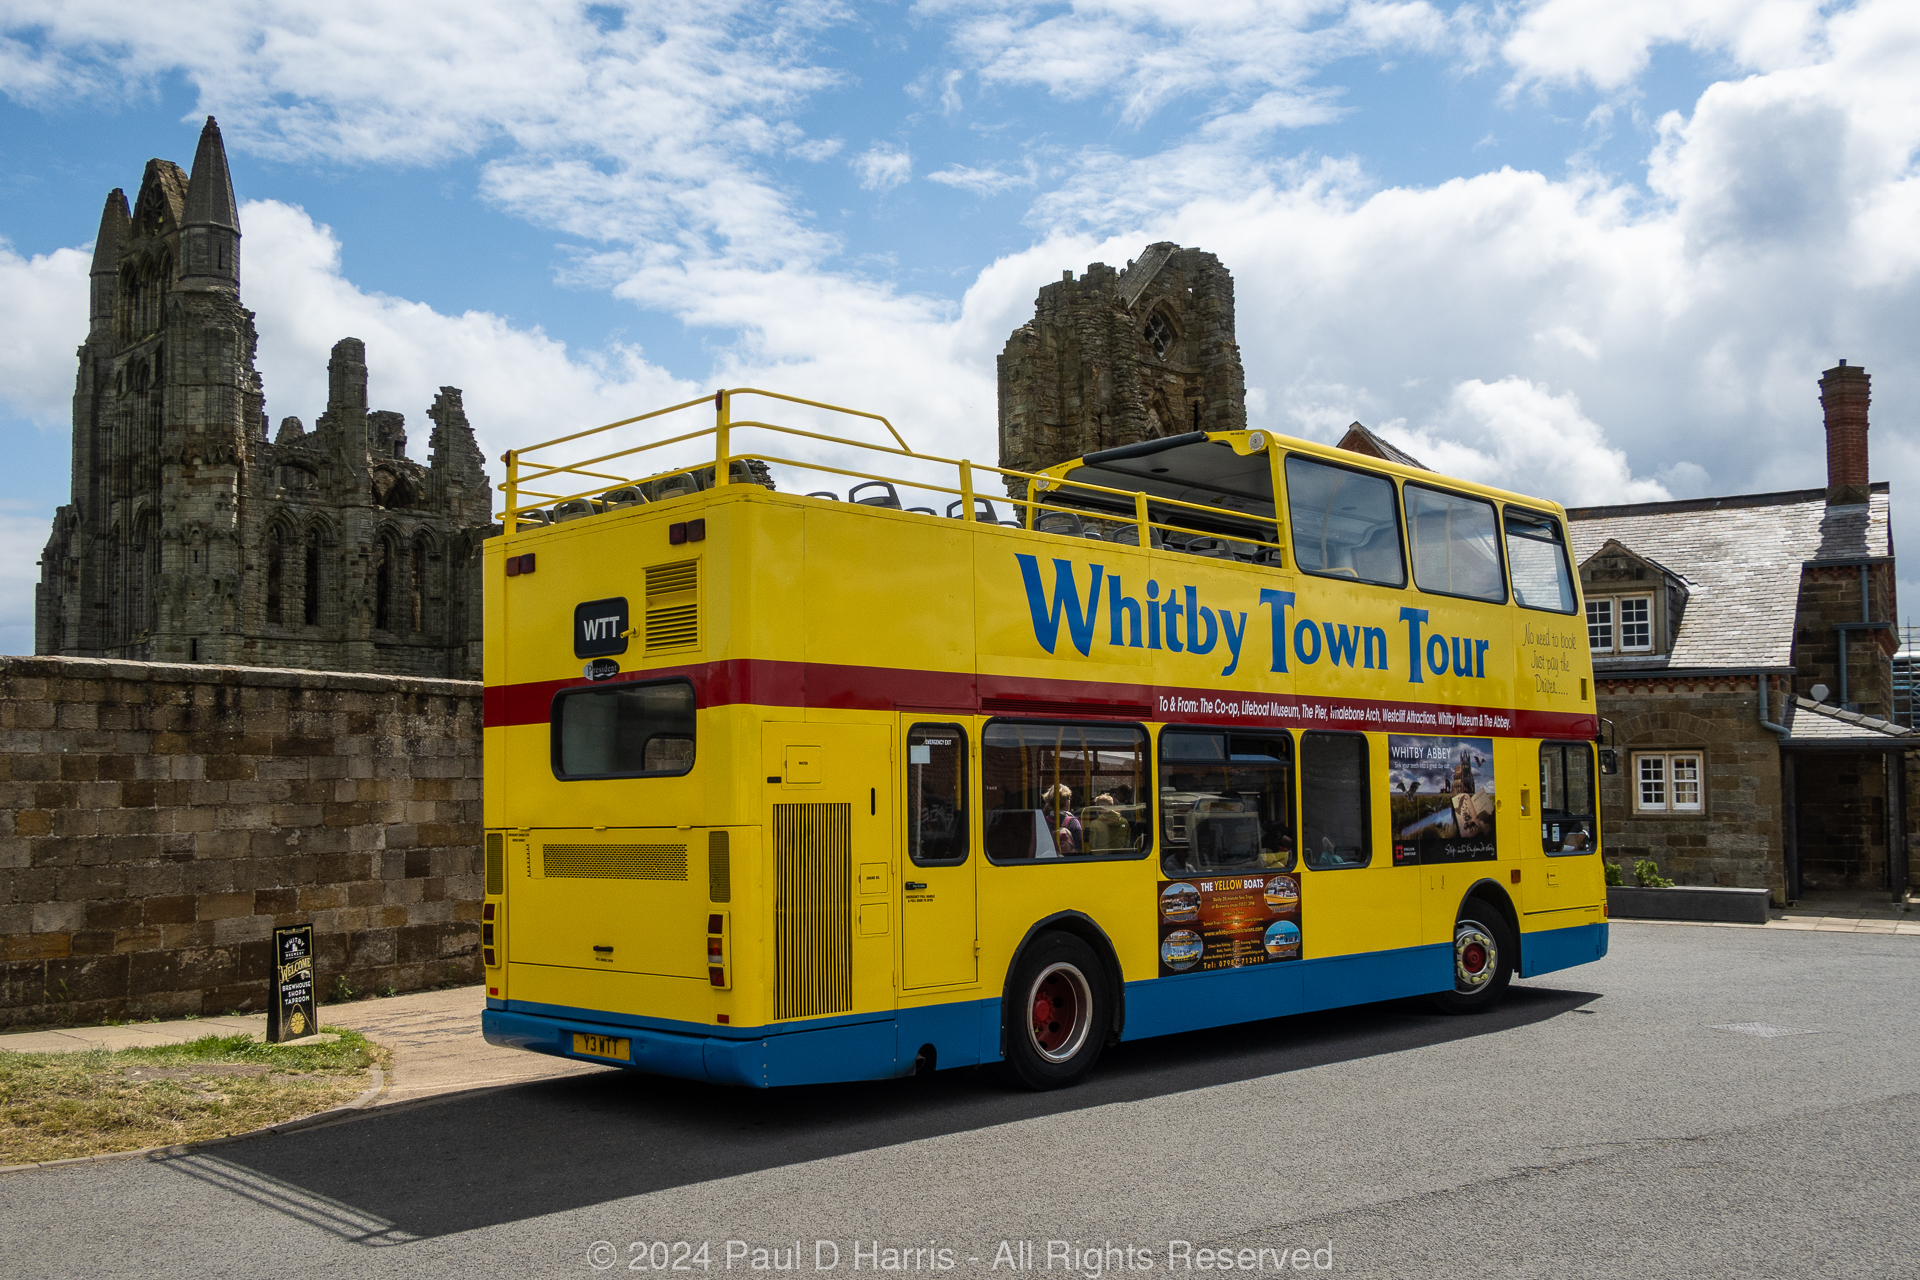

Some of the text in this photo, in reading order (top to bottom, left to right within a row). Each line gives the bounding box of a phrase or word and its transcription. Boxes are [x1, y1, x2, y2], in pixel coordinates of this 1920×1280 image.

[1014, 553, 1489, 683] Whitby Town Tour
[583, 616, 620, 641] WTT
[1522, 622, 1577, 650] No need to book
[587, 664, 617, 677] President
[1531, 650, 1570, 678] Just pay the
[1159, 696, 1168, 712] To
[1170, 696, 1176, 712] &
[1178, 697, 1199, 713] From:
[1200, 698, 1213, 714] The
[1214, 699, 1240, 718] Co-op,
[1241, 700, 1270, 717] Lifeboat
[1271, 702, 1301, 720] Museum,
[1302, 704, 1313, 719] The
[1315, 704, 1328, 722] Pier,
[1365, 707, 1381, 724] Arch,
[1382, 708, 1406, 723] Westcliff
[1406, 710, 1437, 726] Attractions,
[1438, 711, 1455, 728] Whitby
[1456, 713, 1479, 727] Museum
[1479, 714, 1483, 727] &
[1484, 714, 1493, 728] The
[1493, 715, 1511, 731] Abbey.
[1391, 746, 1451, 759] WHITBY ABBEY
[1200, 878, 1264, 892] THE YELLOW BOATS
[284, 937, 305, 949] WHITBY
[280, 957, 311, 984] WELCOME
[1203, 961, 1217, 969] Tel:
[1241, 955, 1265, 964] 712419
[282, 980, 311, 992] BREWHOUSE
[285, 995, 310, 1005] TAPROOM
[583, 1034, 618, 1055] Y3 WTT
